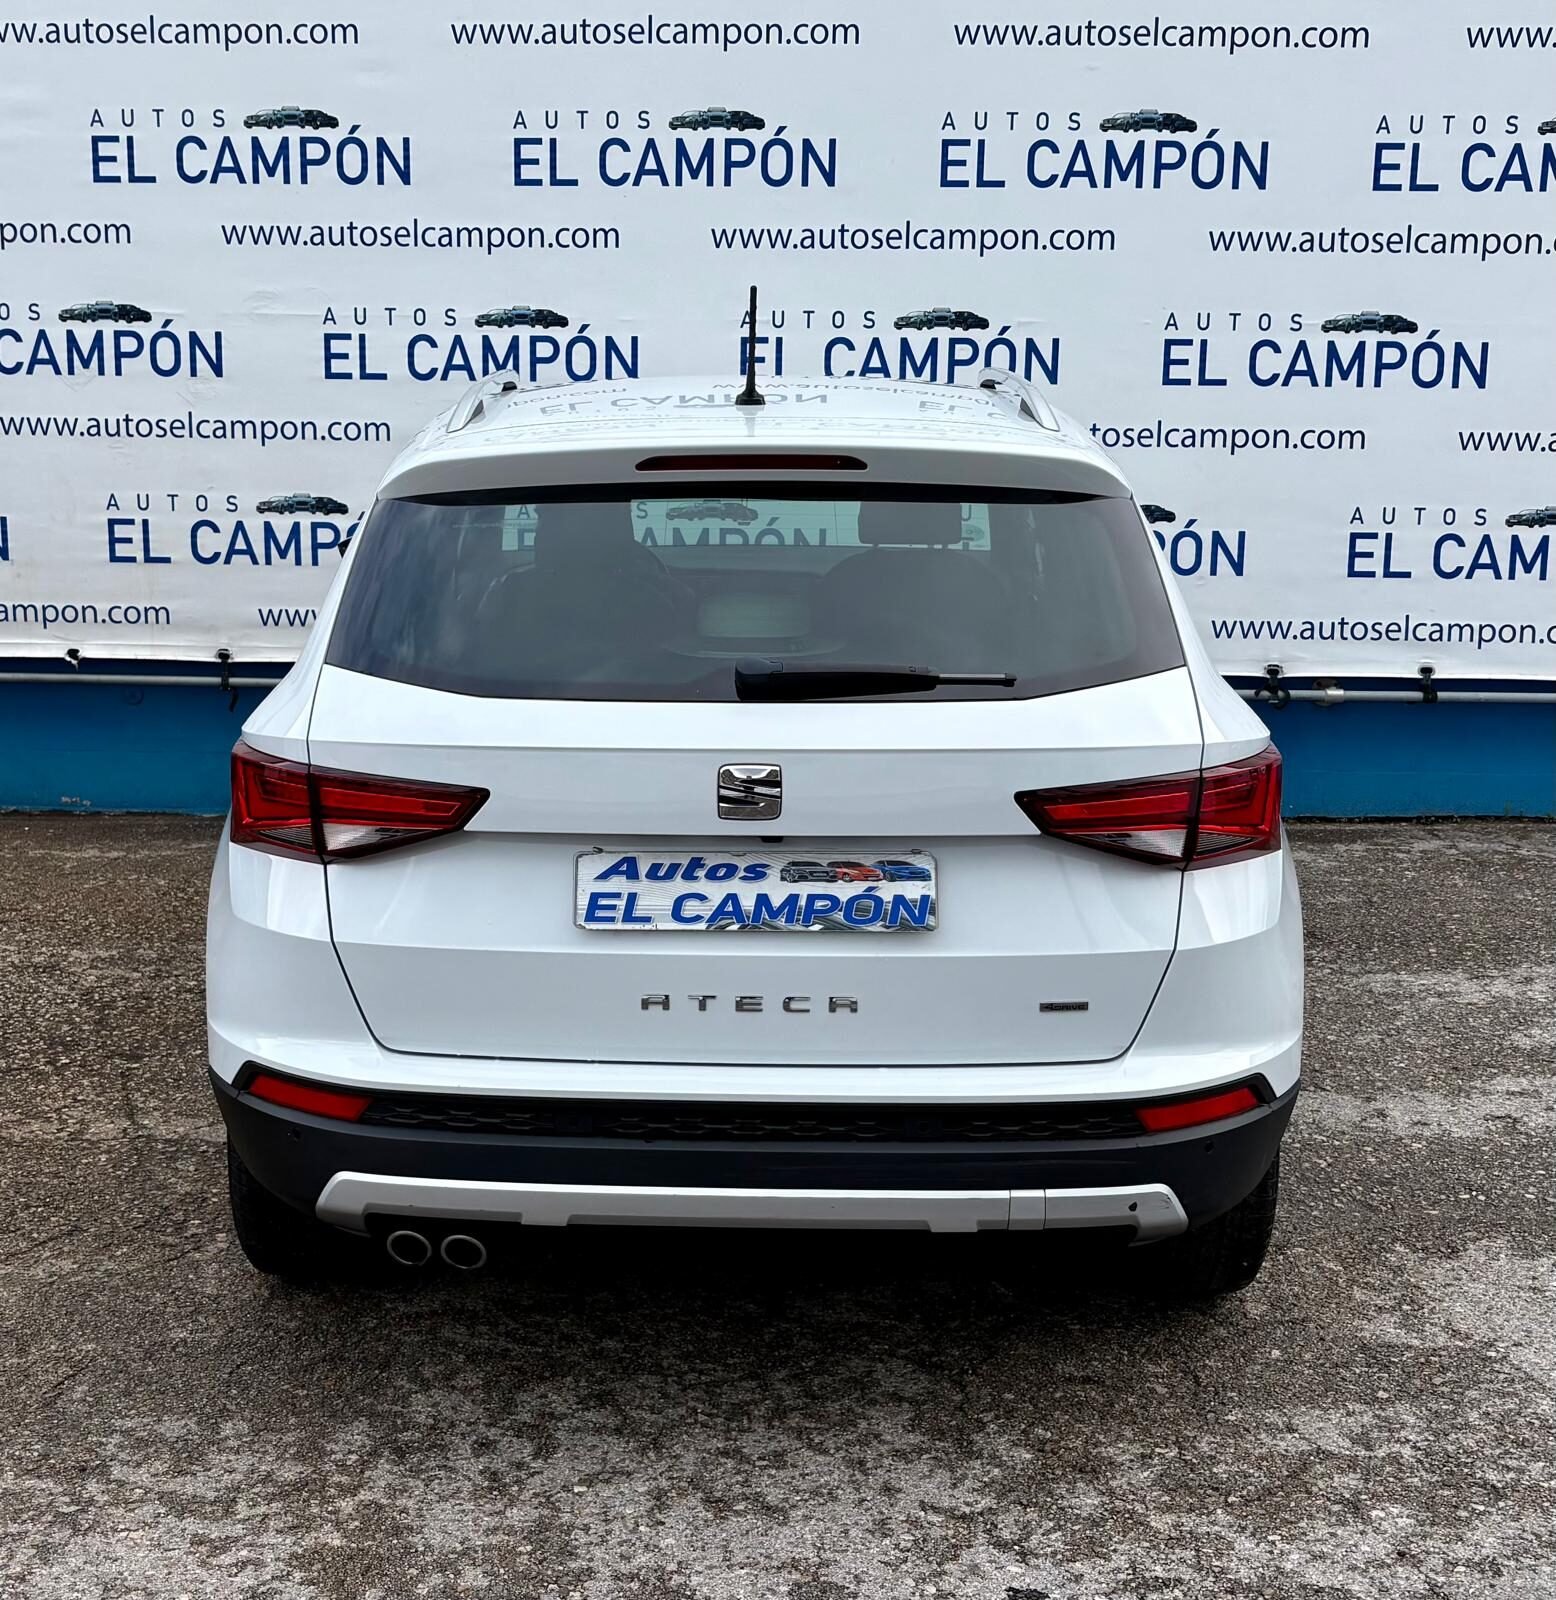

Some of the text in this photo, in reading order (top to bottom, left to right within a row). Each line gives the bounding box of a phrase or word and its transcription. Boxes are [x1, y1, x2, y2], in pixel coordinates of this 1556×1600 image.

[451, 15, 860, 51] www.autoselcampon.com
[954, 17, 1369, 54] www.autoselcampon.com
[1467, 26, 1556, 48] www.
[90, 109, 225, 128] AUTOS
[513, 111, 650, 130] AUTOS
[942, 112, 1080, 131] AUTOS
[1376, 115, 1519, 135] AUTOS
[92, 125, 410, 186] EL CAMPÓN
[514, 127, 836, 188] EL CAMPÓN
[940, 129, 1268, 190] EL CAMPÓN
[1373, 142, 1438, 192] EL
[0, 222, 131, 250] pon.com
[222, 219, 620, 255] www.autoselcampon.com
[712, 221, 1115, 257] www.autoselcampon.com
[1209, 224, 1556, 261] www.autoselcampon.
[323, 307, 456, 327] AUTOS
[740, 310, 876, 329] AUTOS
[1165, 312, 1302, 332] AUTOS
[0, 319, 224, 378] CAMPÓN
[324, 324, 639, 381] EL CAMPÓN
[1162, 330, 1489, 389] EL CAMPÓN
[0, 412, 391, 447] www.autoselcampon.com
[107, 494, 239, 513] AUTOS
[1350, 507, 1486, 527] AUTOS
[108, 517, 172, 564] EL
[1346, 531, 1550, 581] EL CAM
[258, 608, 317, 627] ww
[593, 856, 771, 883] Autos
[583, 886, 933, 927] EL CAMPÓN
[641, 994, 858, 1013] ATECA
